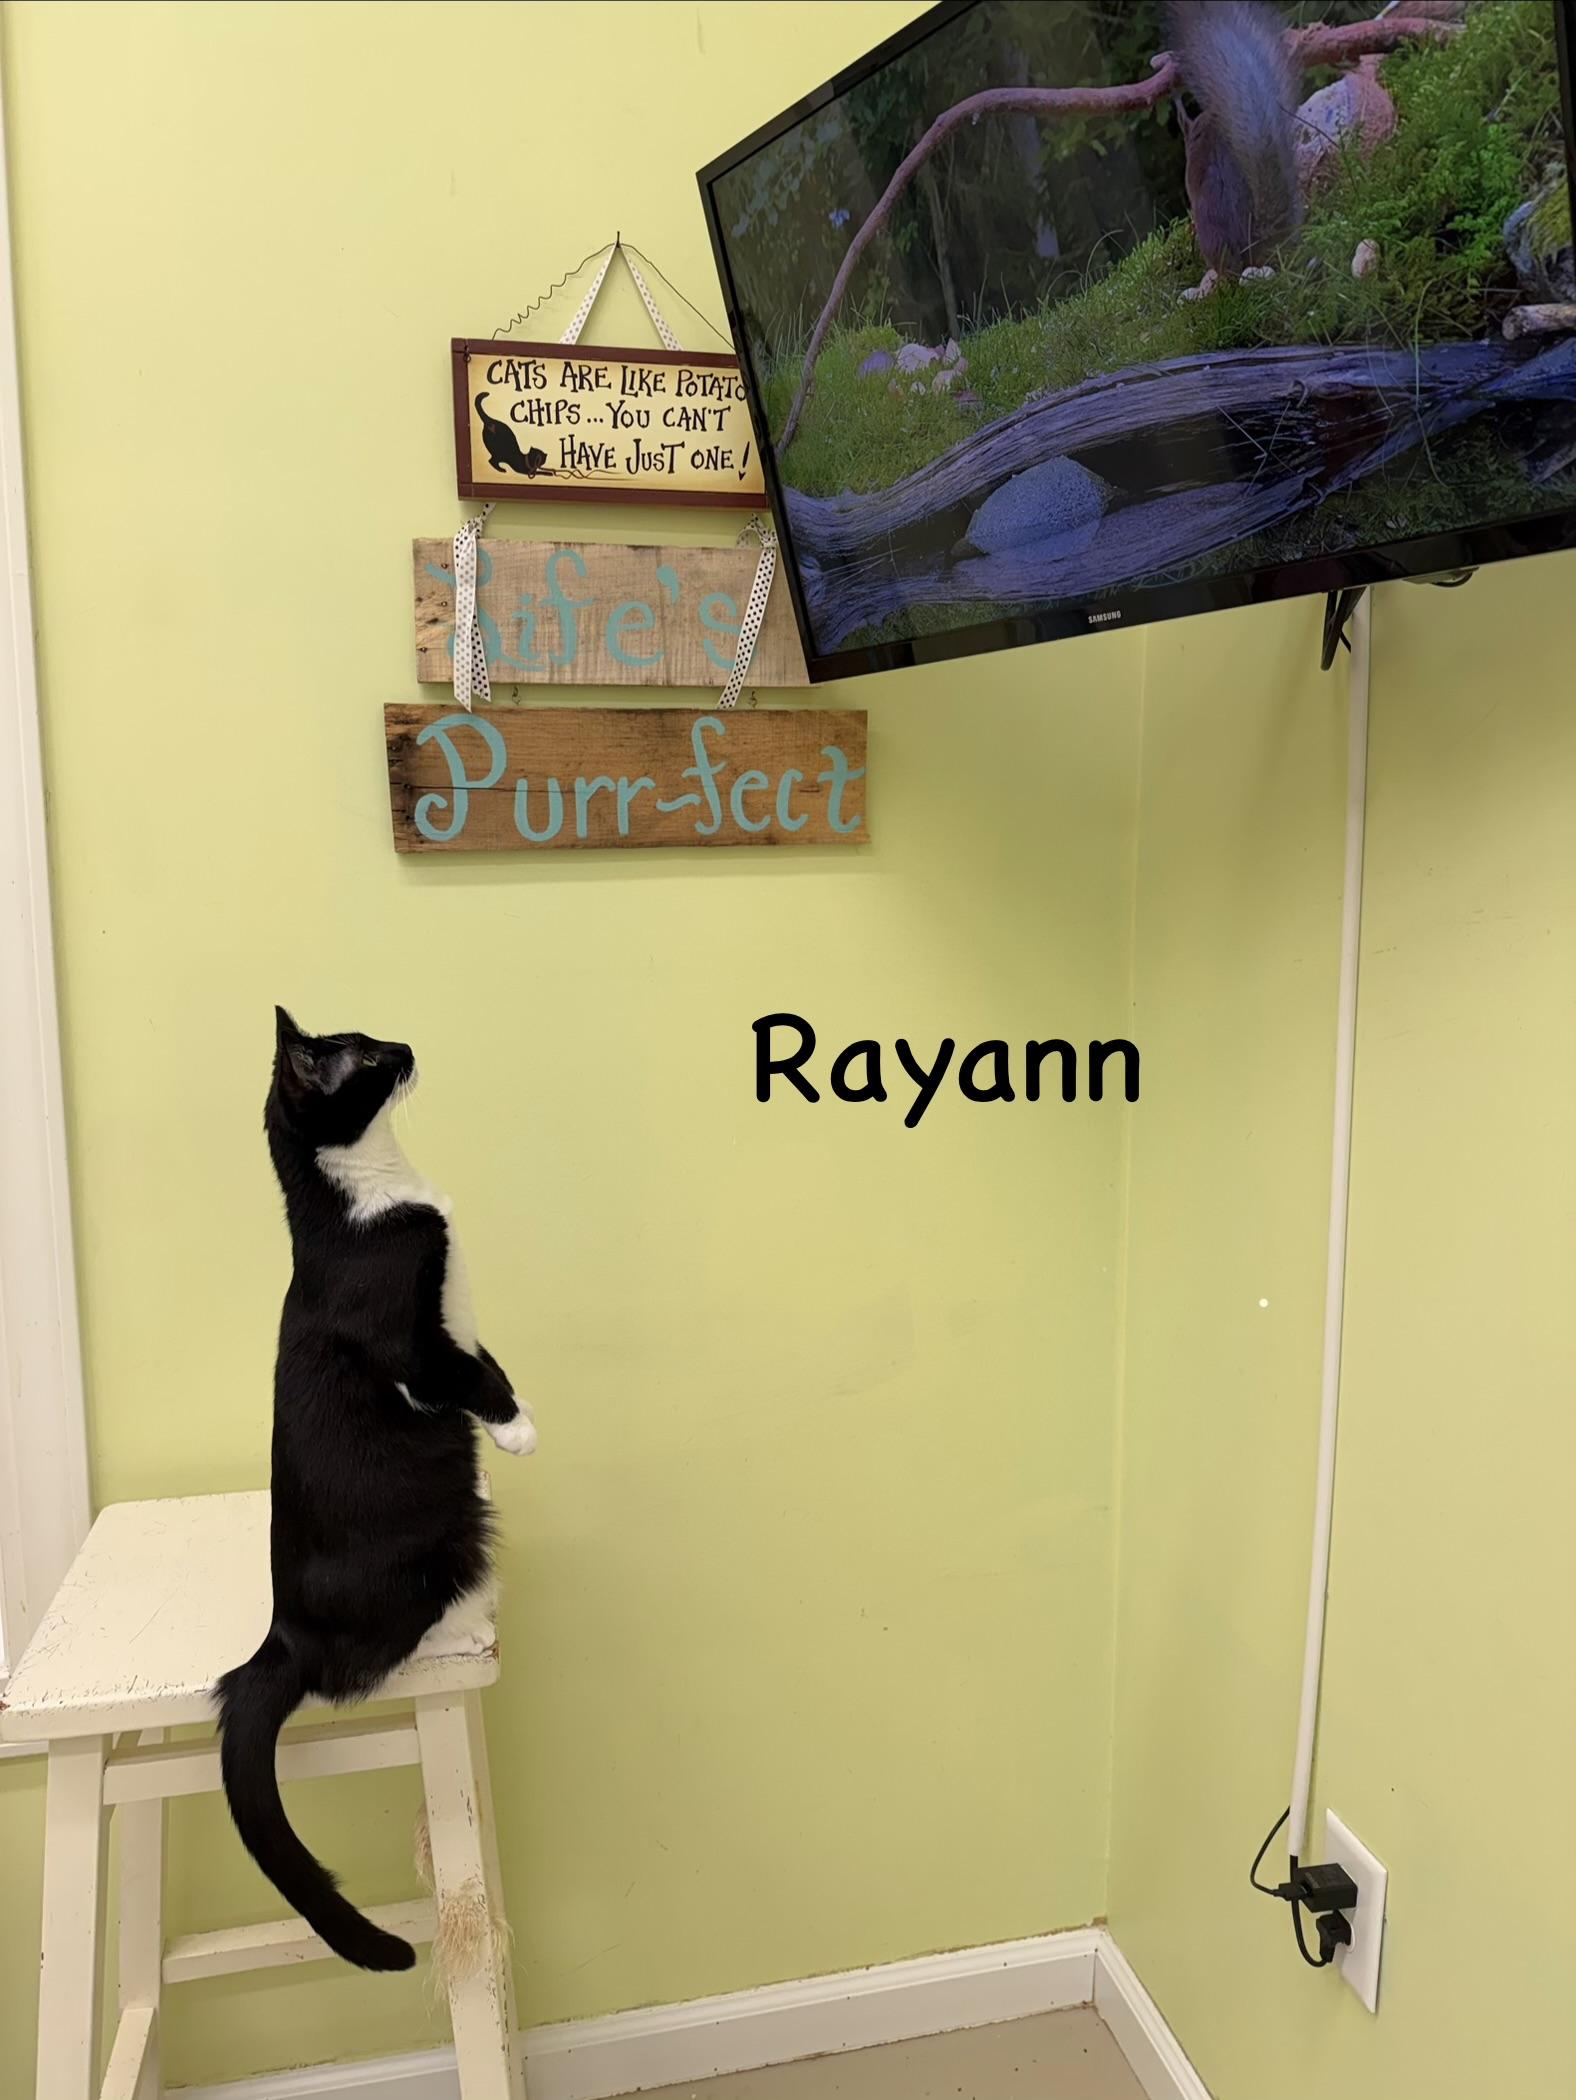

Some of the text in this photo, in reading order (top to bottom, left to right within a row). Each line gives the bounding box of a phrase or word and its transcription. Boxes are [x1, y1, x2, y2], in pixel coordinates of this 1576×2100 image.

[486, 359, 748, 402] CATS ARE LIKE POTATO
[662, 406, 731, 432] CAN'T
[559, 434, 616, 470] HAVE
[626, 438, 686, 474] JUST
[1088, 610, 1121, 624] SAMSUNG
[414, 713, 866, 842] Purr-fect
